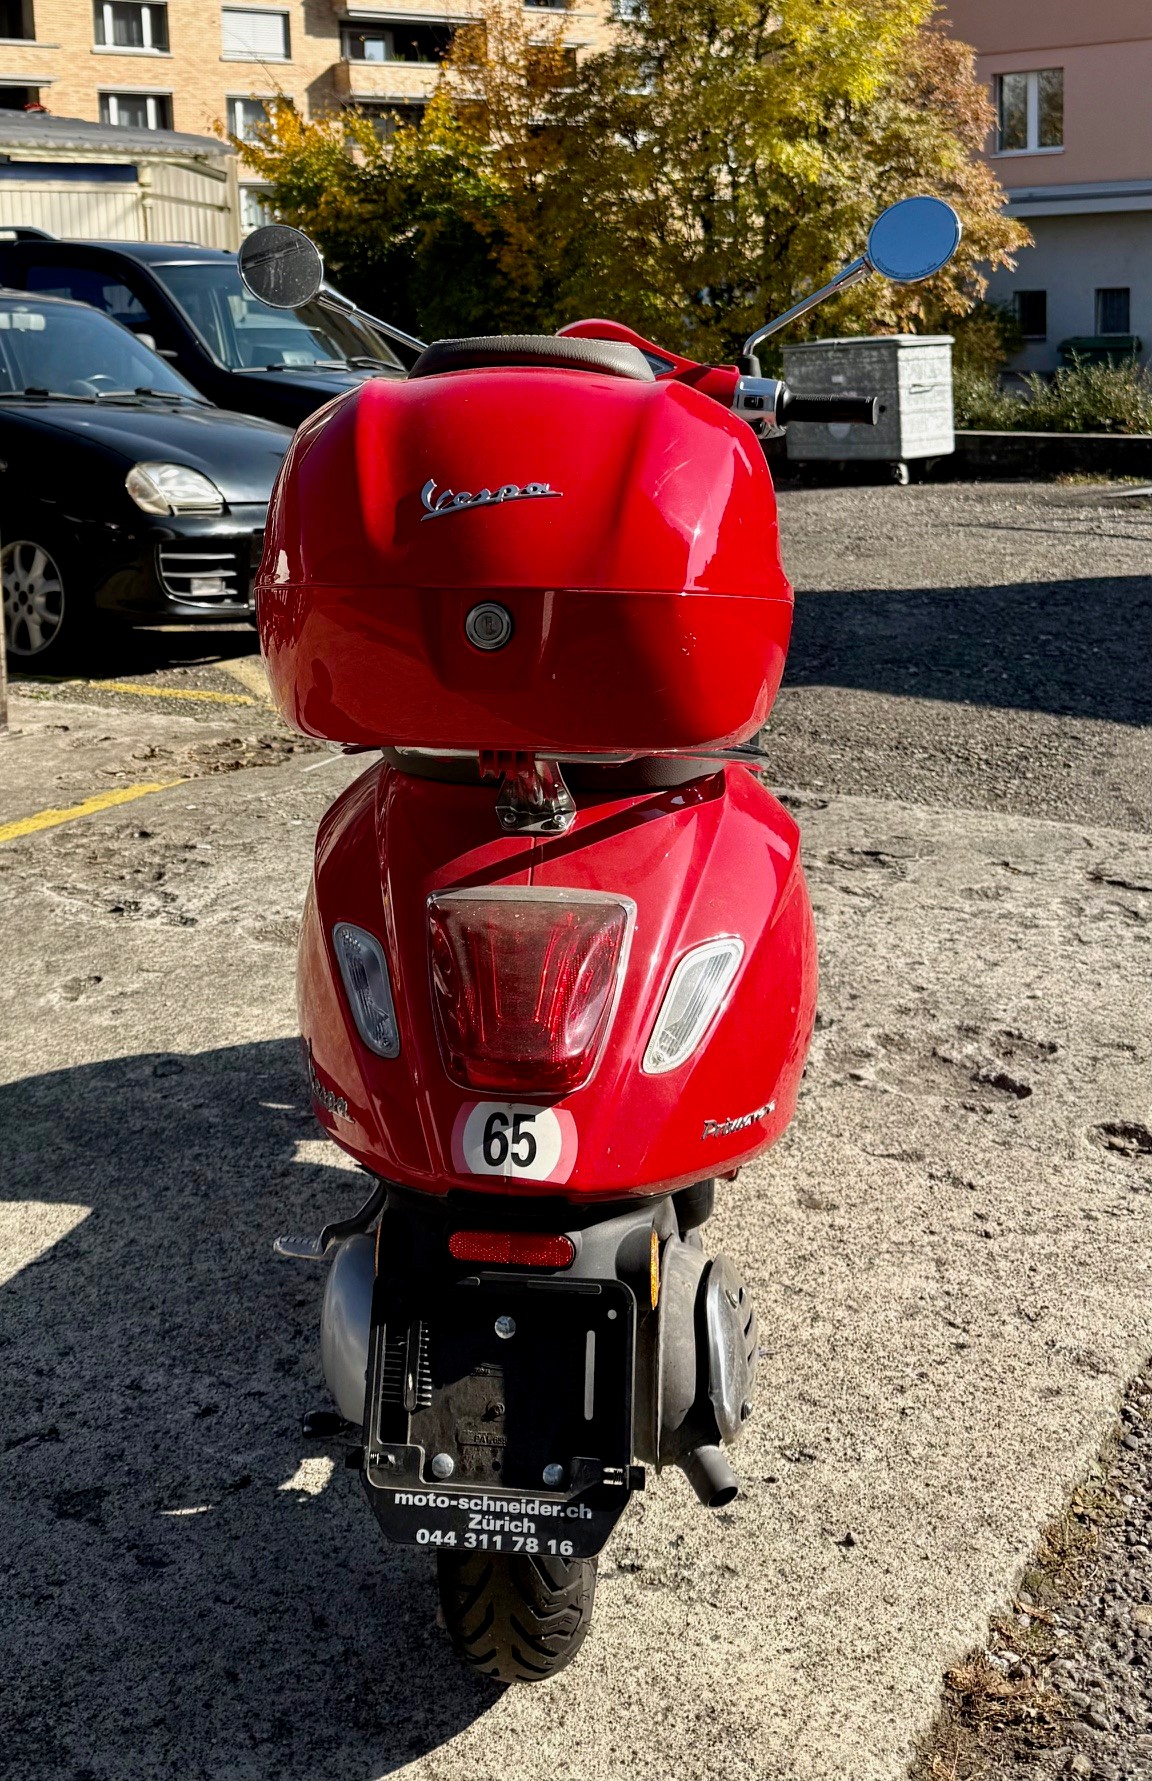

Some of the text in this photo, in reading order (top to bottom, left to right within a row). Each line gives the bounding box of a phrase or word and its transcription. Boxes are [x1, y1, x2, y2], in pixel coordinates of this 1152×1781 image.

[421, 478, 563, 521] Vespa
[482, 1111, 537, 1168] 65
[394, 1492, 592, 1520] moto-schneider.ch
[468, 1513, 536, 1534] Zürich
[416, 1528, 574, 1556] 044 311 78 16
